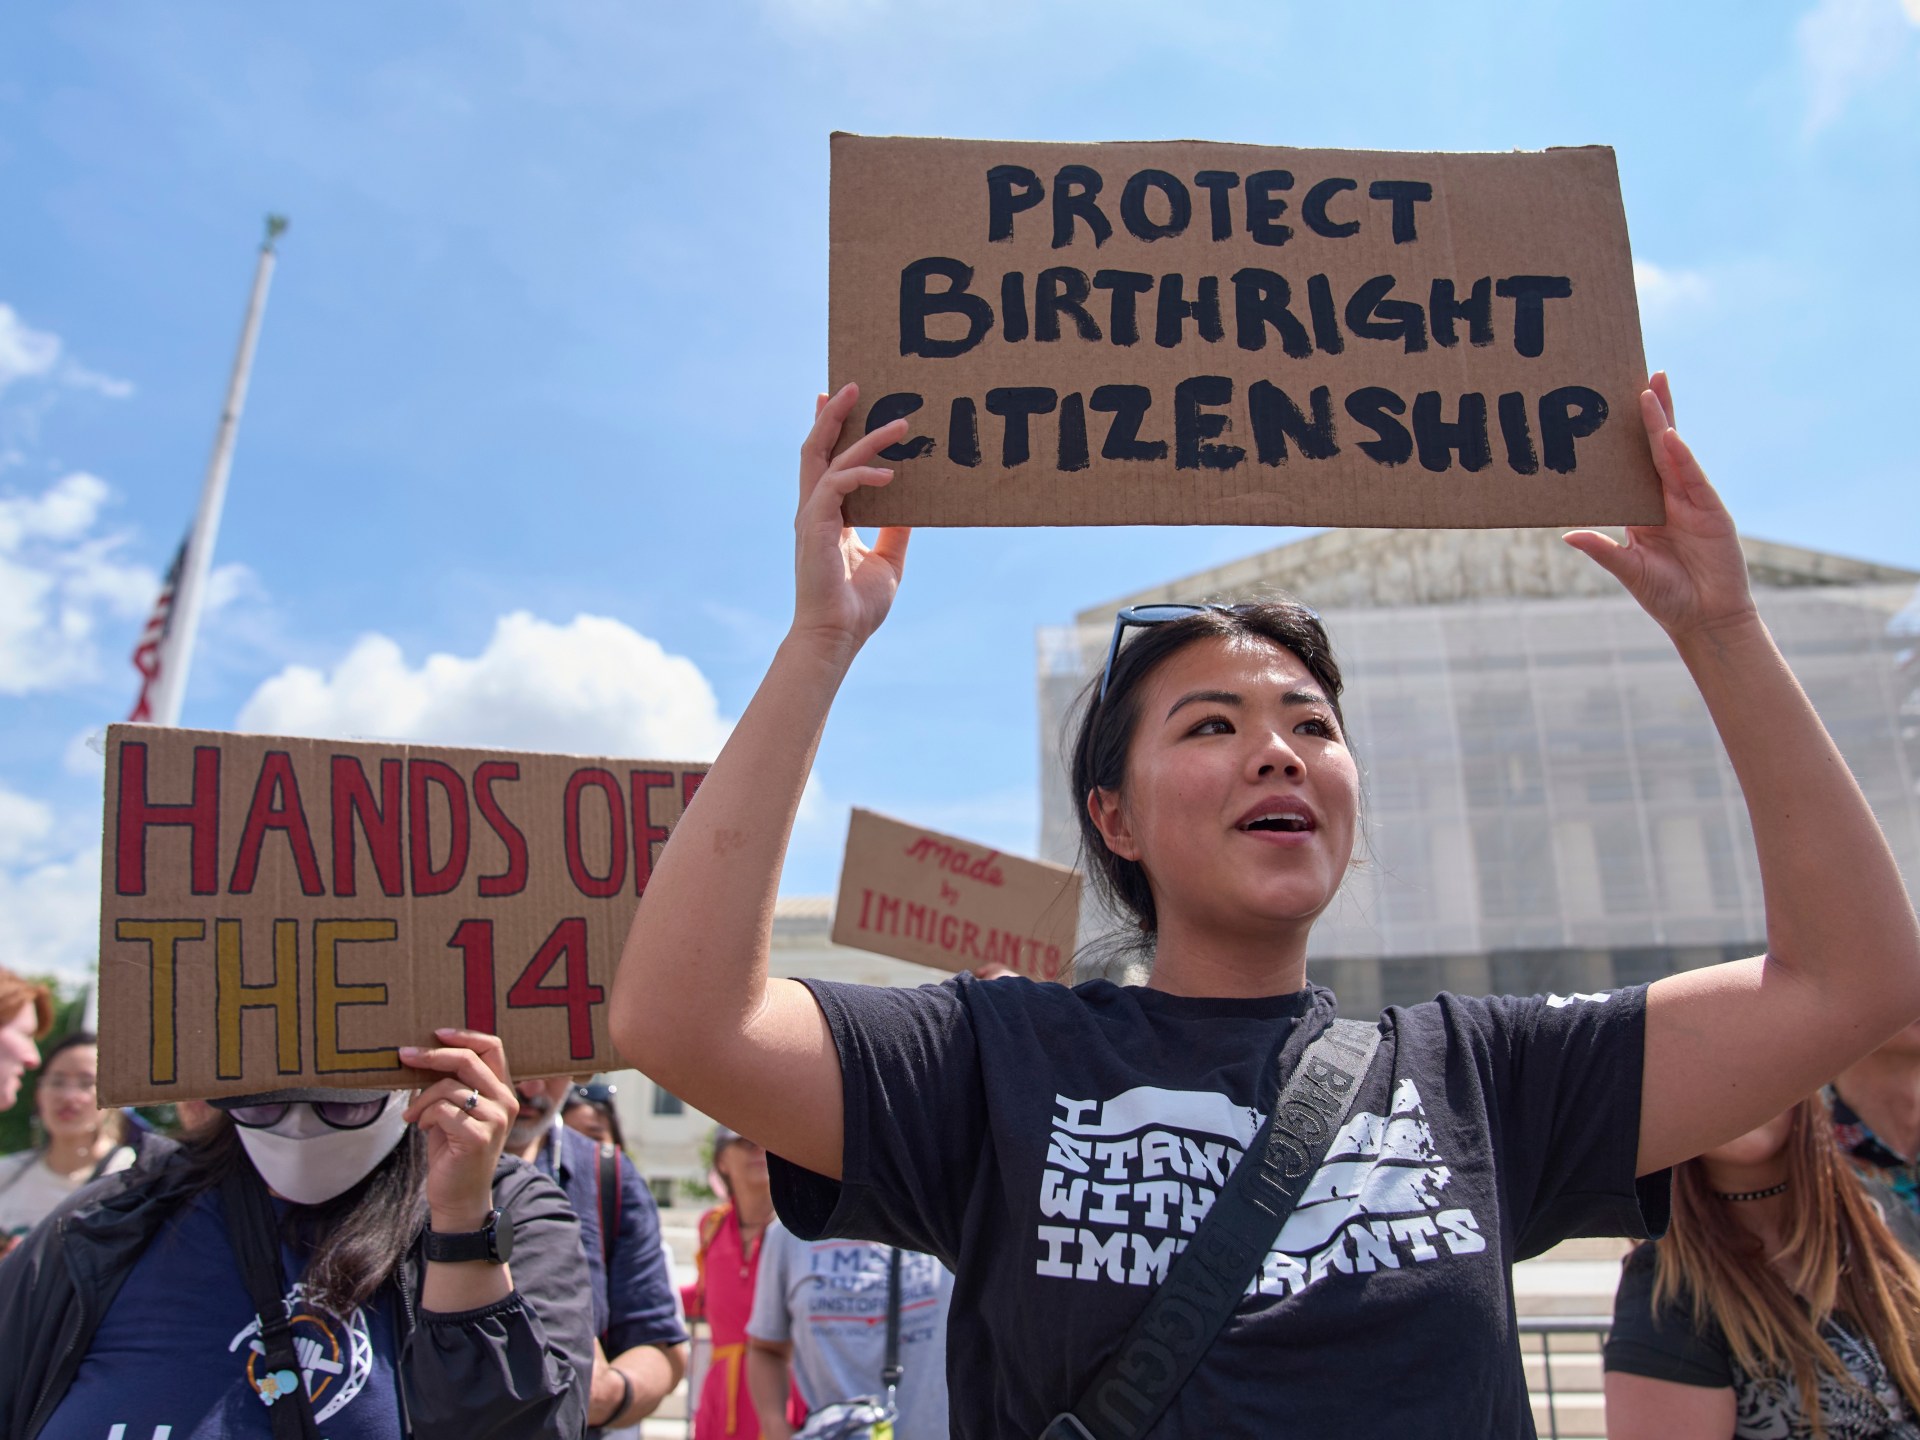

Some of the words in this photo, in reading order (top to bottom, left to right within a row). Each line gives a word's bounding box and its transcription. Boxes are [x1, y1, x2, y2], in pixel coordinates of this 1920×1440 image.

[986, 165, 1432, 248] PROTECT
[900, 256, 1572, 358] BIRTHRIGHT
[864, 376, 1609, 475] CITIZENSHIP
[115, 741, 529, 898] HANDS
[564, 767, 708, 898] OF
[857, 888, 1063, 980] IMMIGRANTS
[115, 918, 402, 1086] THE
[447, 918, 605, 1061] 14
[1052, 1093, 1102, 1135] I
[1036, 1209, 1486, 1296] IMMRANTS
[1096, 1222, 1258, 1437] BAGGU
